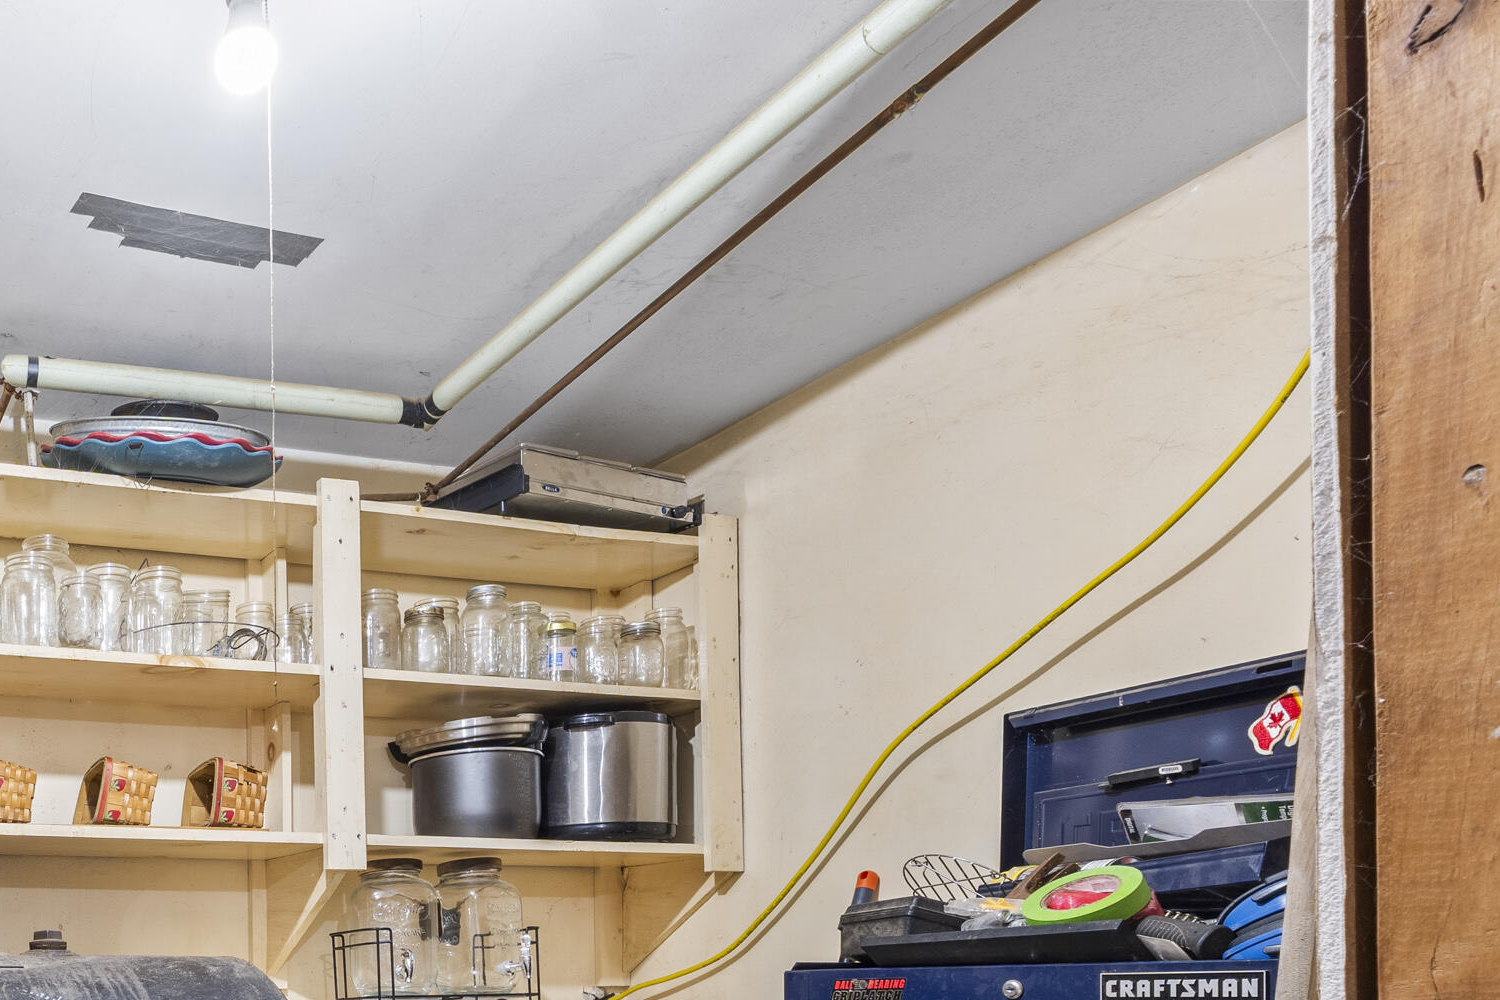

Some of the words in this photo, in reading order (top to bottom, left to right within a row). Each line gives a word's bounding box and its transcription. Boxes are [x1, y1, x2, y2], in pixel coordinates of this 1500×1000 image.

[834, 980, 853, 989] BALL
[867, 979, 906, 989] BEARING
[1105, 978, 1259, 998] CRAFTSMAN
